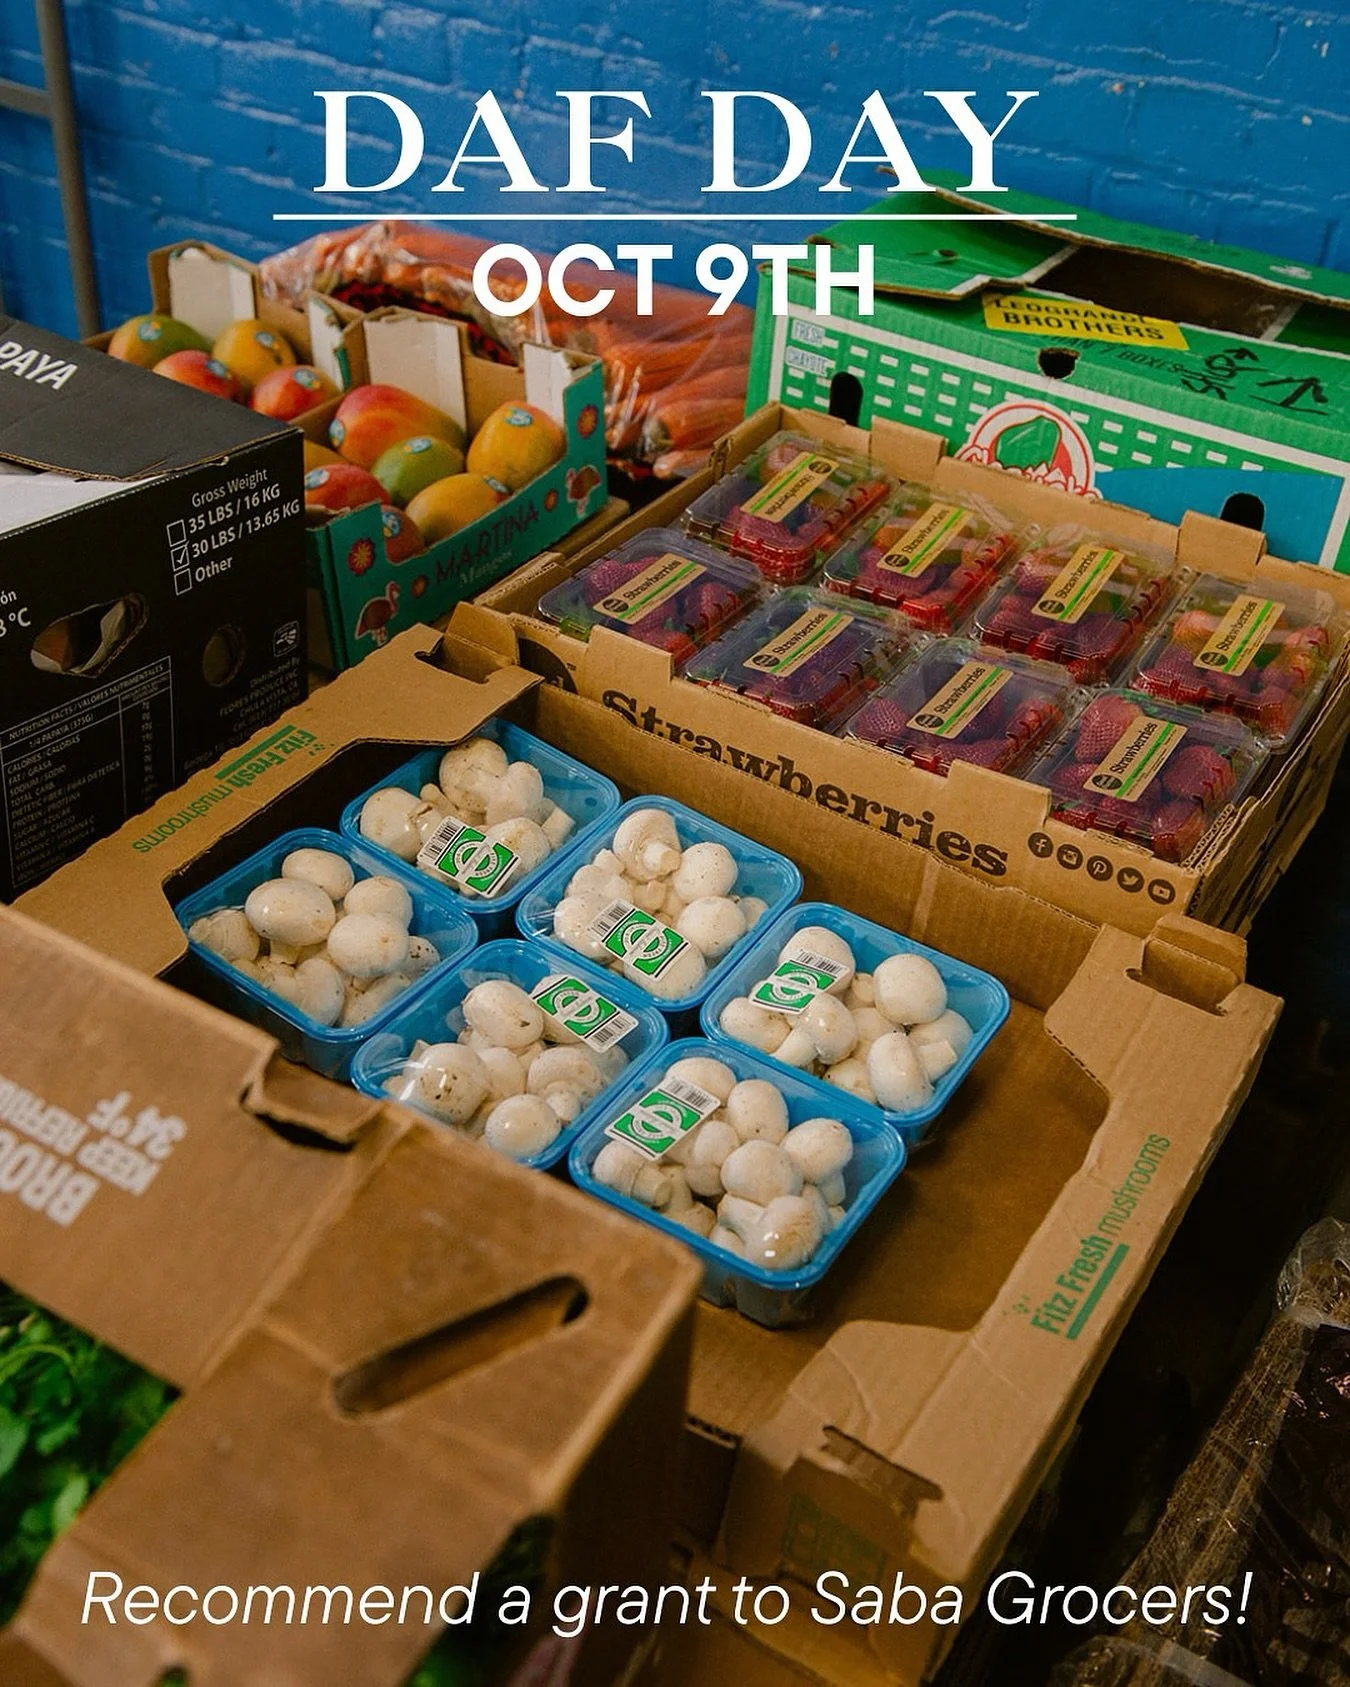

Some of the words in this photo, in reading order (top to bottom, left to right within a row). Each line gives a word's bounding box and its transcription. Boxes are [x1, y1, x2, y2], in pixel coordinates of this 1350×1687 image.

[1003, 311, 1165, 341] BROTHERS
[188, 513, 206, 534] 35
[208, 502, 234, 526] LBS
[244, 492, 260, 510] 16
[262, 483, 281, 504] KG
[192, 486, 226, 508] Gross
[226, 468, 268, 494] Weight
[191, 539, 209, 559] 30
[211, 526, 236, 550] LBS
[246, 507, 280, 534] 13.65
[282, 499, 300, 519] KG
[435, 500, 539, 583] MARTINA
[902, 508, 950, 553] Strawberries
[195, 557, 233, 583] Other
[622, 560, 682, 600] Strawberries
[1054, 551, 1099, 599] Strawberries
[772, 612, 828, 655] Strawberries
[1215, 600, 1258, 651] Strawberries
[933, 667, 986, 715] Strawberries
[9, 715, 50, 741] NUTRITION
[50, 704, 74, 722] FACTS
[42, 723, 69, 743] PAPAYA
[274, 729, 317, 755] Fitz
[7, 752, 42, 774] CALORIES
[46, 734, 81, 757] CALORIAS
[227, 751, 287, 788] Fresh
[1109, 722, 1158, 774] Strawberries
[602, 688, 1009, 877] Strawberries
[132, 784, 233, 853] mushrooms
[86, 1091, 188, 1161] 34°F
[1030, 1292, 1076, 1335] Fitz
[1055, 1234, 1112, 1293] Fresh
[1098, 1132, 1171, 1239] mushrooms
